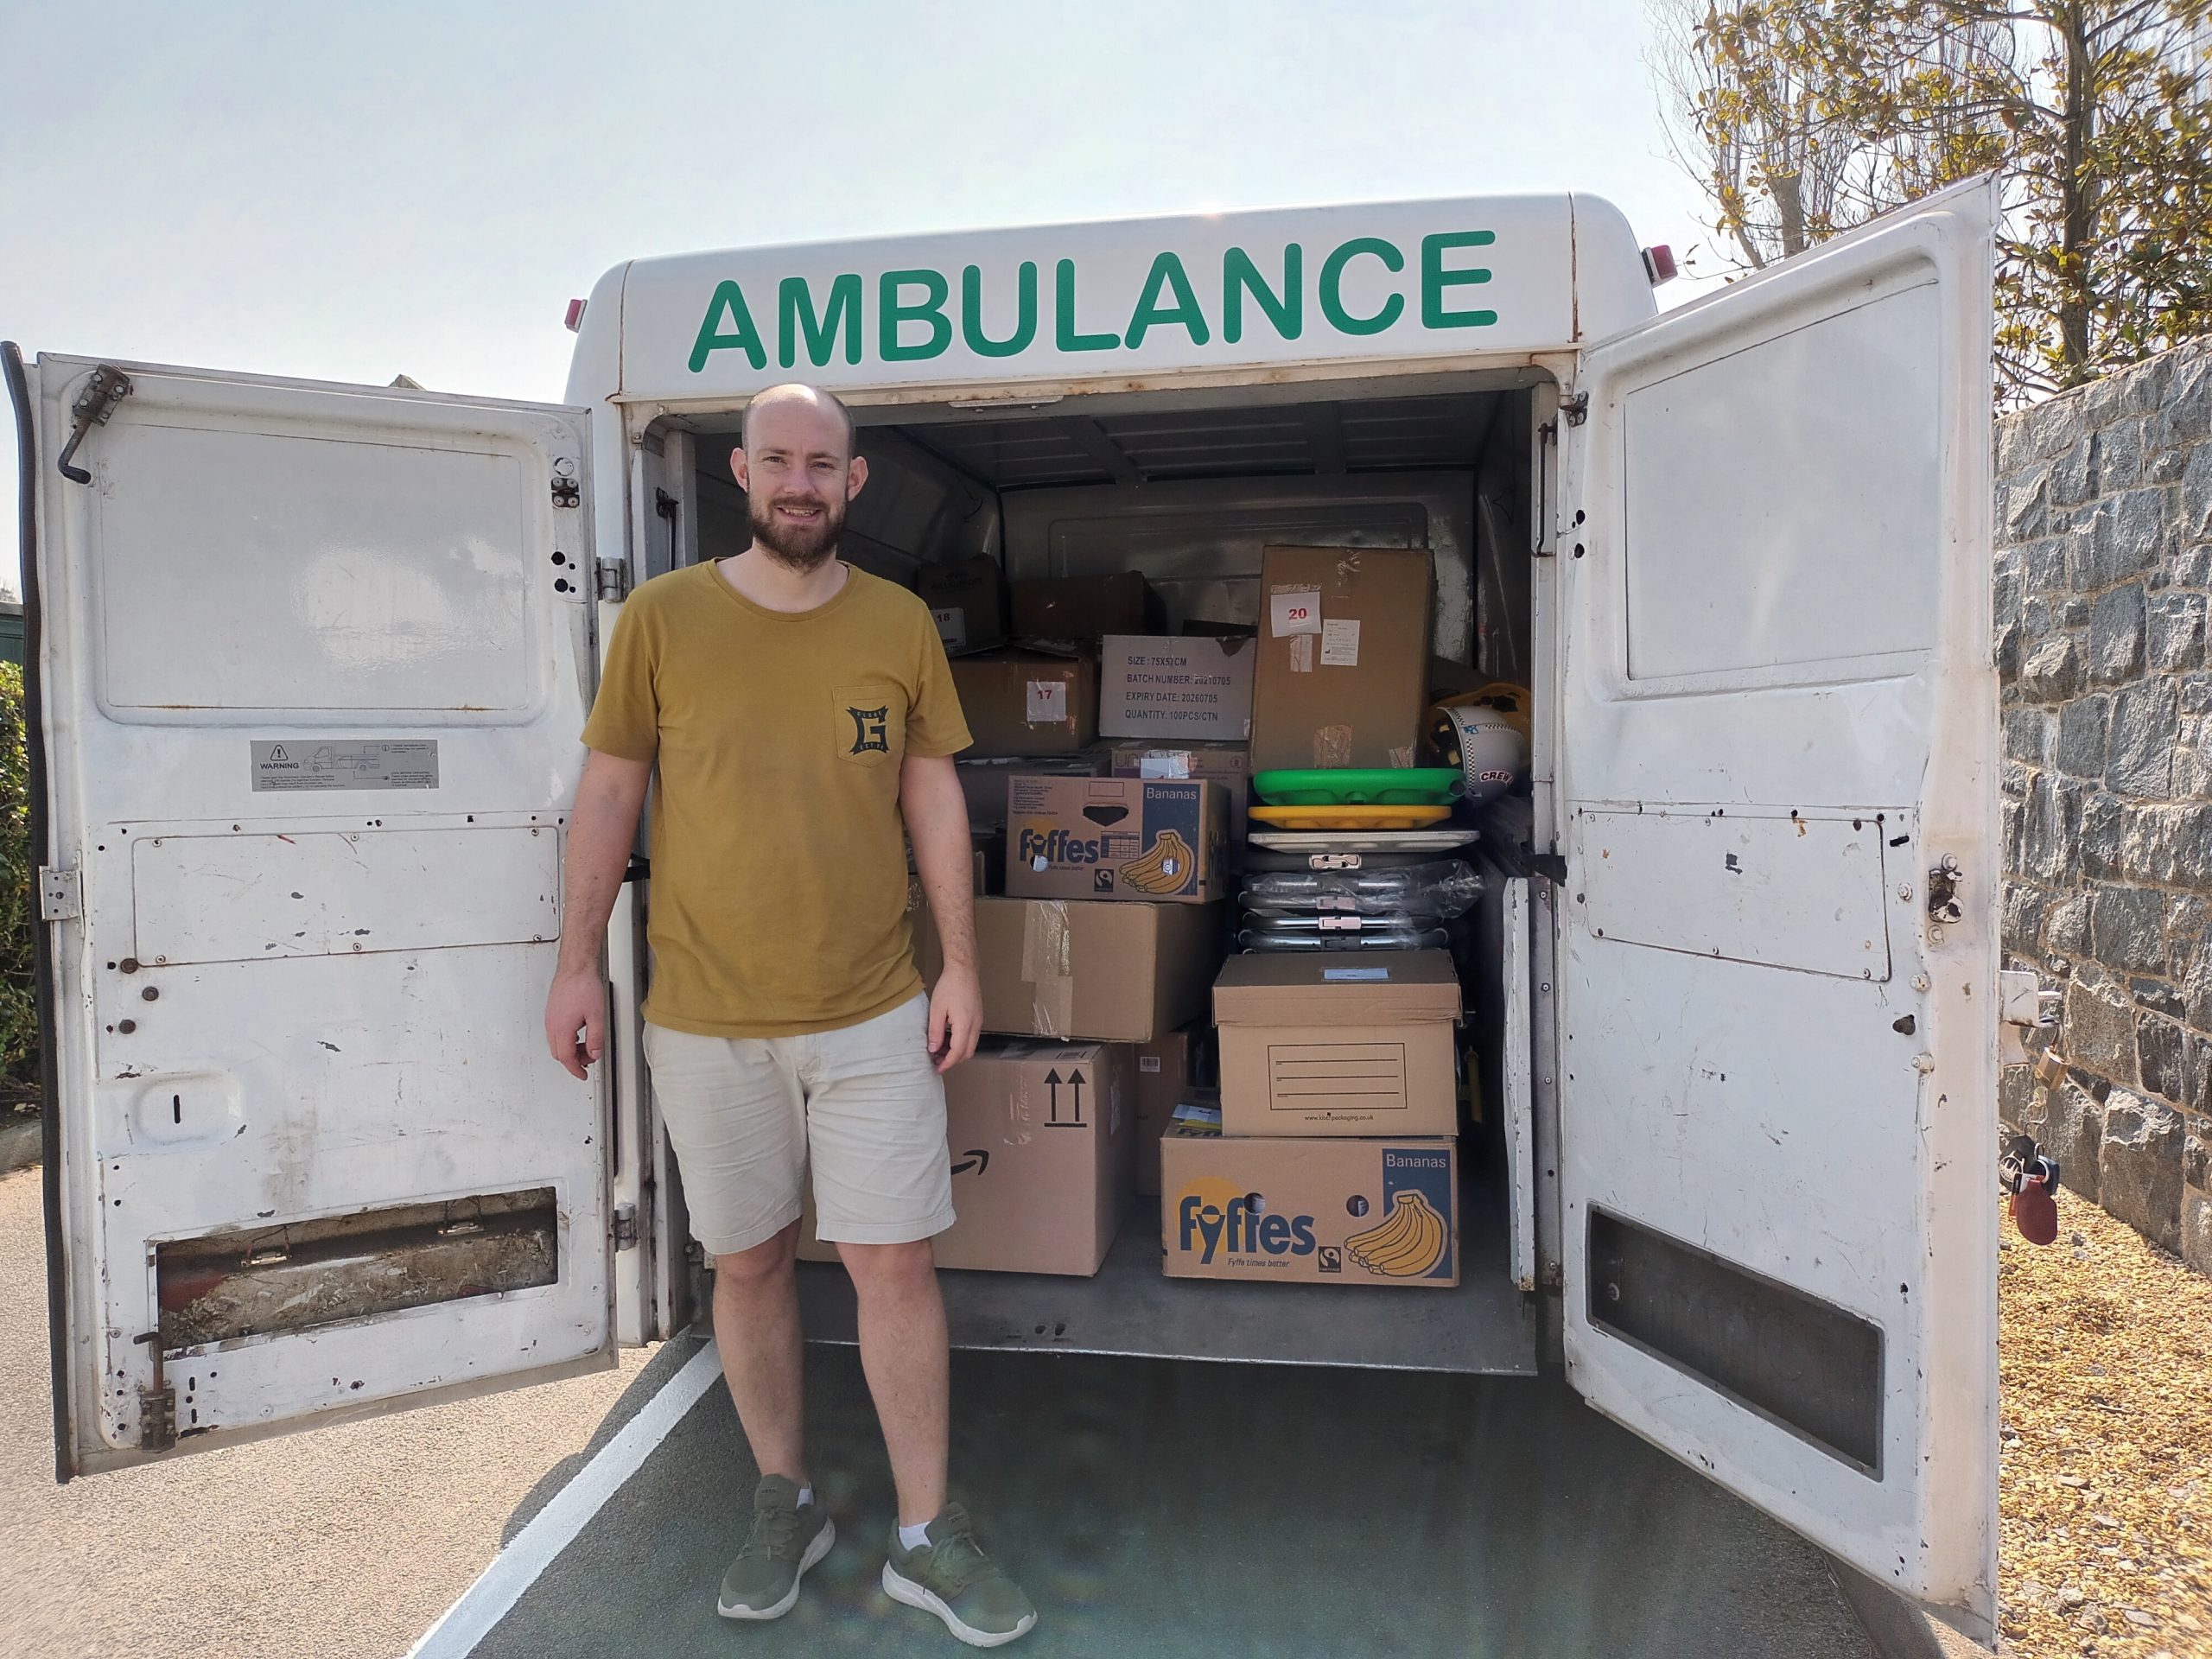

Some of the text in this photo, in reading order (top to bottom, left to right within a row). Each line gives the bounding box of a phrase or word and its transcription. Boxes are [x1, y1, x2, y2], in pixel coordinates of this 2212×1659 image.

[688, 230, 1497, 374] AMBULANCE
[936, 613, 950, 622] 18
[1288, 607, 1307, 620] 20
[1151, 657, 1187, 666] 75X57CM
[1127, 674, 1230, 685] BATCH NUMBER: 20210705
[1037, 690, 1052, 700] 17
[1126, 691, 1217, 703] EXPIRY DATE: 20260705
[1125, 709, 1217, 721] QUANTITY: 100PCS/CTN
[1481, 772, 1510, 783] CREW
[1147, 786, 1197, 800] Bananas
[1386, 1154, 1446, 1168] Bananas
[1228, 1258, 1245, 1267] Fyffe
[1268, 1259, 1290, 1268] better
